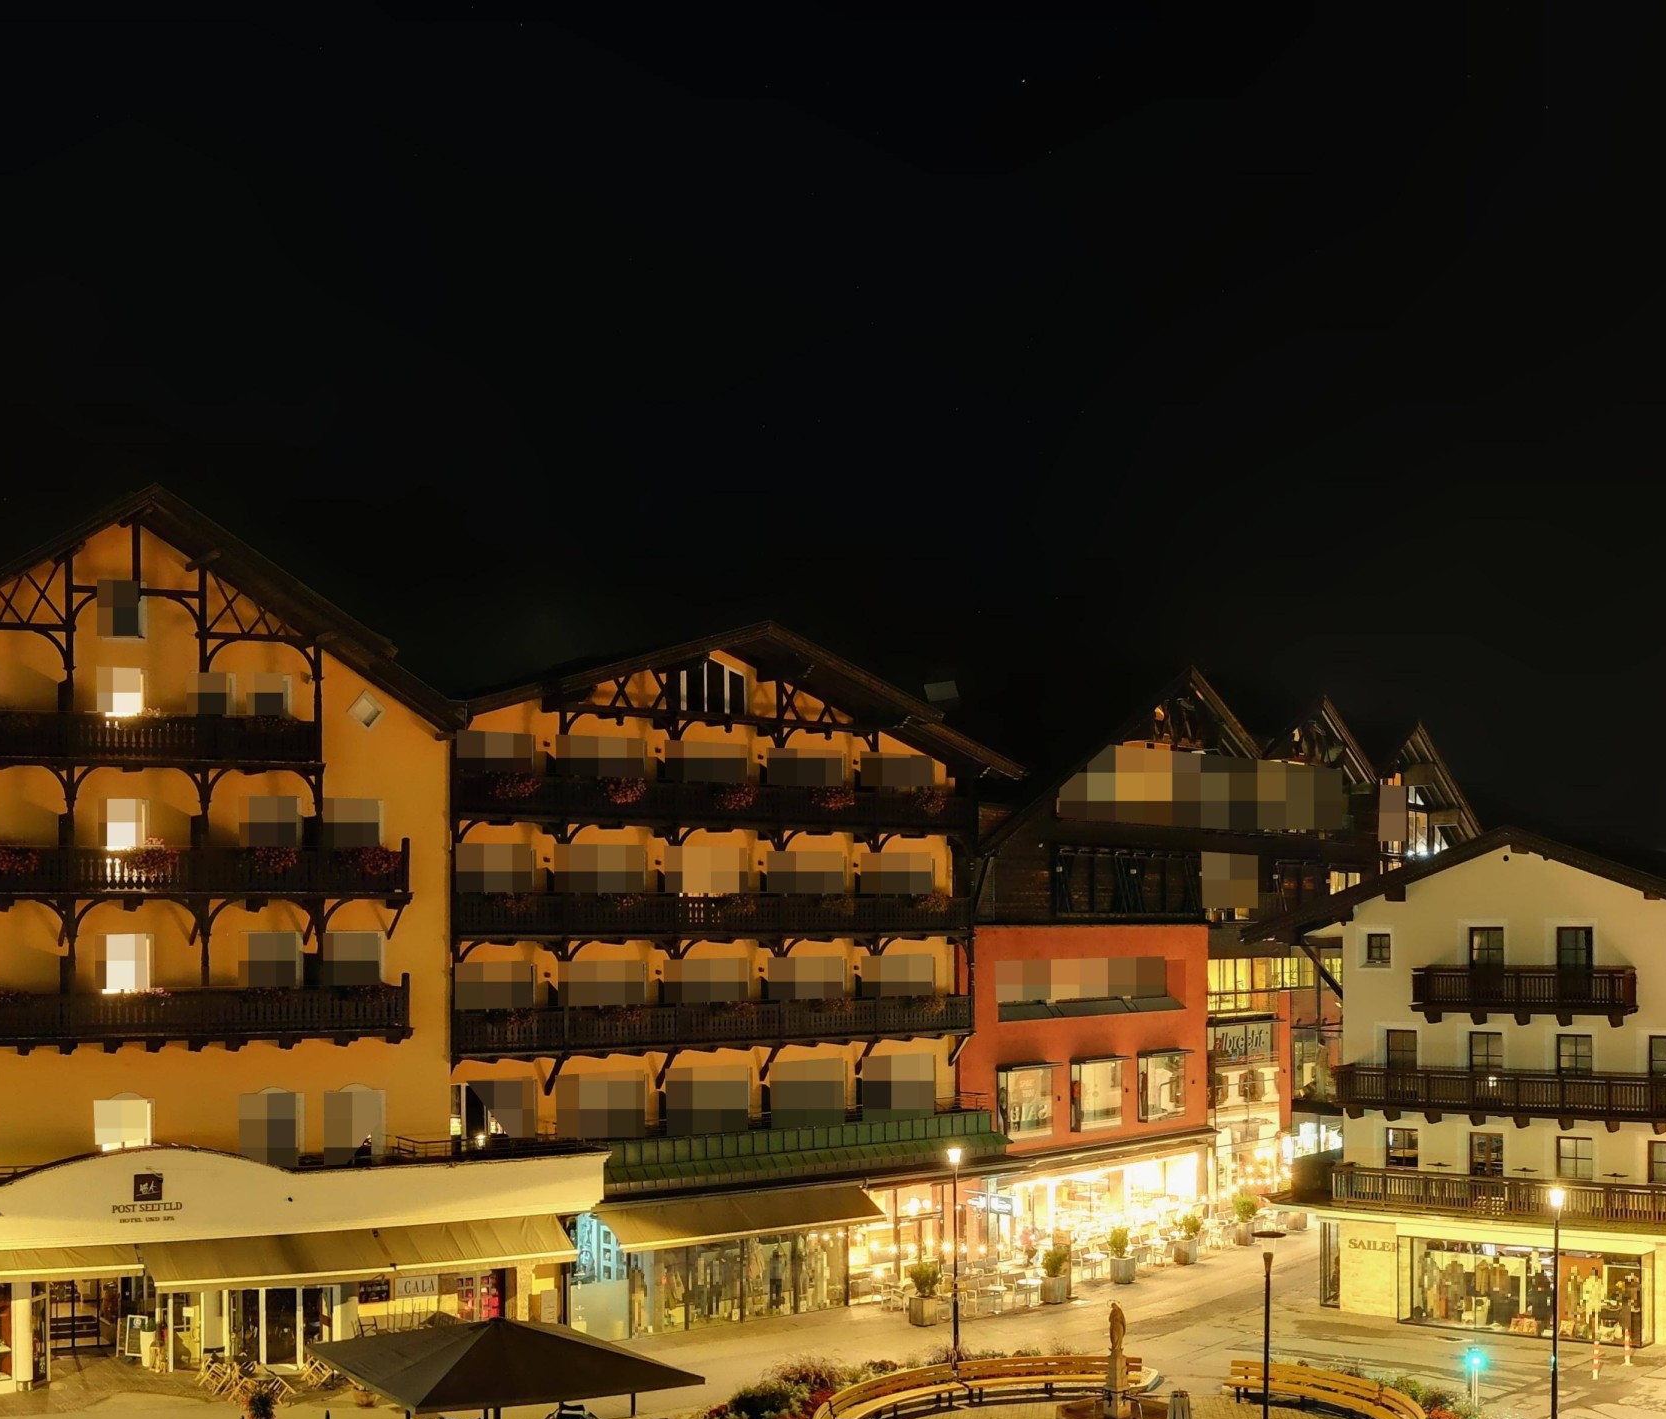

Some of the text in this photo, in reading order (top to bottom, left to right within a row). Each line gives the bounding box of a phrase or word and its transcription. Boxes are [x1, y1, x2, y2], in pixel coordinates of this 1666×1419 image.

[112, 1201, 183, 1213] POST SEEFELD
[404, 1279, 435, 1294] CALA
